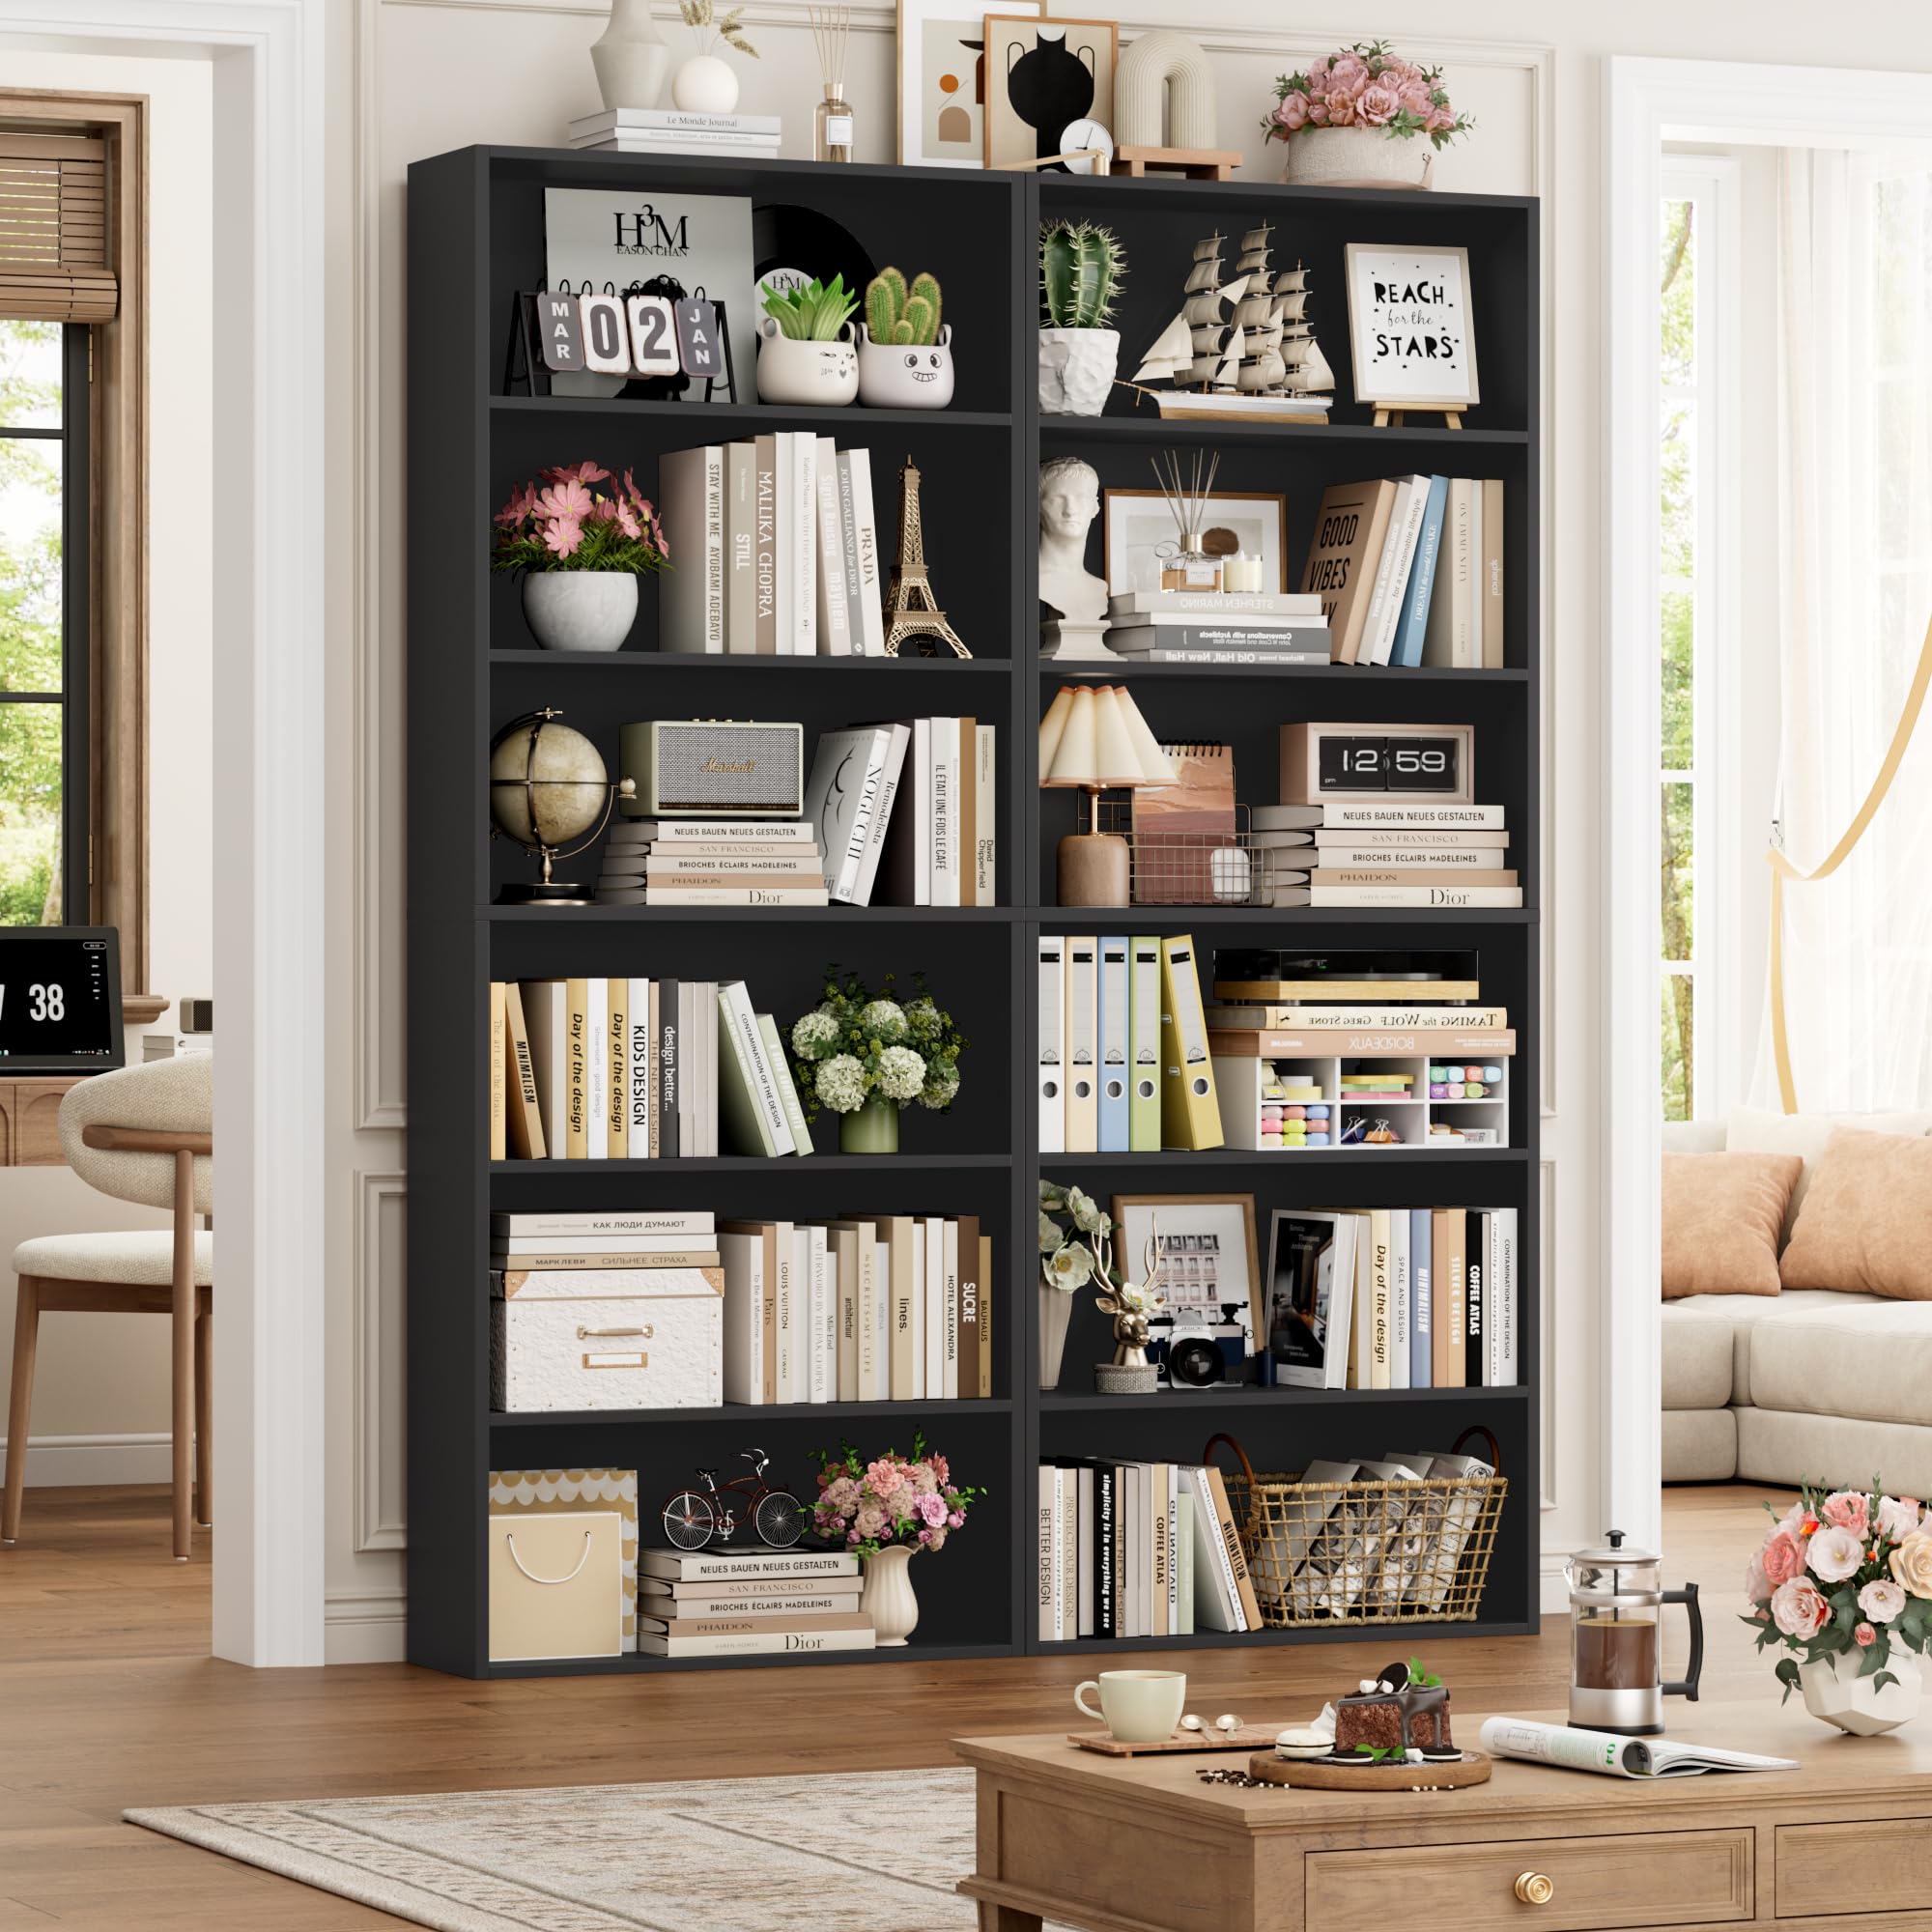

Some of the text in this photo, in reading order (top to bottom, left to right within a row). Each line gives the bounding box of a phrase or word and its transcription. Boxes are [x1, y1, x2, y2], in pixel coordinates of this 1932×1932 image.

[667, 116, 737, 128] Le Monde Journal
[617, 245, 688, 257] EASON CHAN
[1374, 280, 1444, 304] REACH
[1387, 309, 1434, 327] for the
[1377, 333, 1453, 359] STARS
[758, 470, 773, 618] MALLIKA CHOPRA
[1320, 514, 1359, 549] GOOD
[709, 464, 720, 640] STAY WITH ME AYOBAMI ADEBAYO
[736, 533, 751, 570] STILL
[862, 527, 874, 586] PRADA
[1309, 557, 1350, 592] VIBES
[699, 756, 756, 774] Marshall
[1343, 749, 1446, 773] 12 59
[847, 763, 882, 860] NOGUCHI
[872, 781, 895, 845] Remodelista
[1343, 811, 1372, 820] NEUES
[1437, 812, 1485, 821] GESTALTEN
[719, 860, 749, 868] ÉCLAIRS
[978, 839, 986, 889] Chipperfield
[1395, 853, 1427, 862] ÉCLAIRS
[1429, 854, 1477, 863] MADELEINES
[749, 890, 783, 904] Dior
[1430, 888, 1470, 905] Dior
[28, 983, 65, 1021] 38
[661, 1026, 676, 1065] design
[516, 1040, 536, 1103] MINIMALISM
[570, 1013, 583, 1133] Day of the design
[611, 1013, 624, 1133] Day of the design
[633, 1025, 646, 1125] KIDS DESIGN
[741, 1013, 781, 1128] CONTAMINATION OF THE DESIGN
[613, 1221, 642, 1230] ЛЮДИ
[644, 1220, 686, 1230] ДУМАЮТ
[651, 1256, 688, 1264] СТРАХА
[754, 1285, 760, 1295] Be
[962, 1282, 977, 1322] SUCRE
[1375, 1244, 1386, 1363] Day of the design
[1417, 1267, 1429, 1333] MINIMALISM
[1469, 1264, 1480, 1336] COFFEE ATLAS
[765, 1297, 774, 1326] Paris
[899, 1297, 910, 1333] lines.
[1504, 1303, 1511, 1313] OF
[1101, 1474, 1111, 1520] simplicity
[1103, 1522, 1111, 1532] is
[1103, 1534, 1111, 1544] in
[700, 1560, 839, 1575] NEUES BAUEN NEUES GESTALTEN
[1040, 1508, 1051, 1605] BETTER DESIGN
[1065, 1496, 1075, 1619] PROTECT OUR DESIGN
[1156, 1517, 1165, 1585] COFFEE ATLAS
[728, 1582, 813, 1593] SAN FRANCISCO
[1101, 1546, 1111, 1595] everything
[710, 1600, 833, 1611] BRIOCHES ÉCLAIRS MADELEINES
[1103, 1597, 1110, 1610] we
[696, 1622, 753, 1632] PHAIDON
[784, 1634, 825, 1650] Dior
